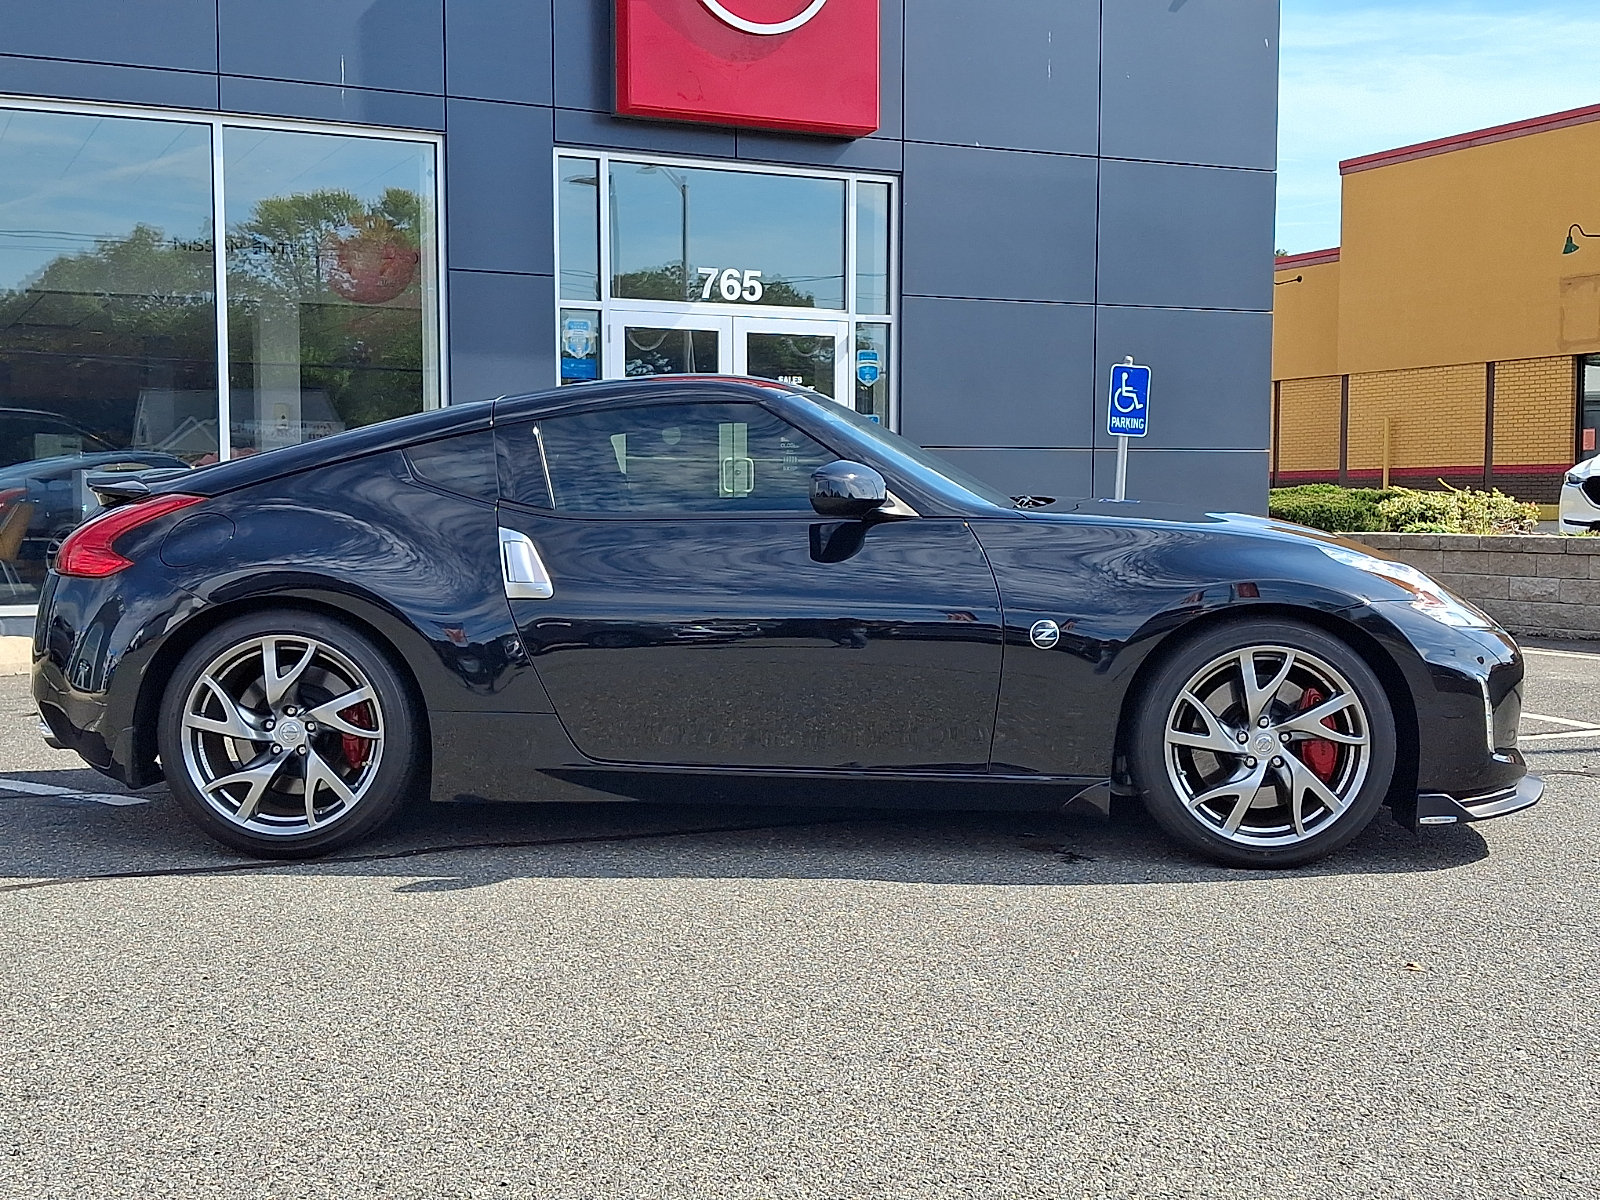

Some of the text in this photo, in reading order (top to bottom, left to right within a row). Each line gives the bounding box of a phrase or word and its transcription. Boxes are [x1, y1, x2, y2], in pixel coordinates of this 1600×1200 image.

[174, 238, 243, 253] NISSN
[697, 267, 763, 302] 765
[1111, 416, 1145, 430] PARKING
[1034, 628, 1057, 641] Z
